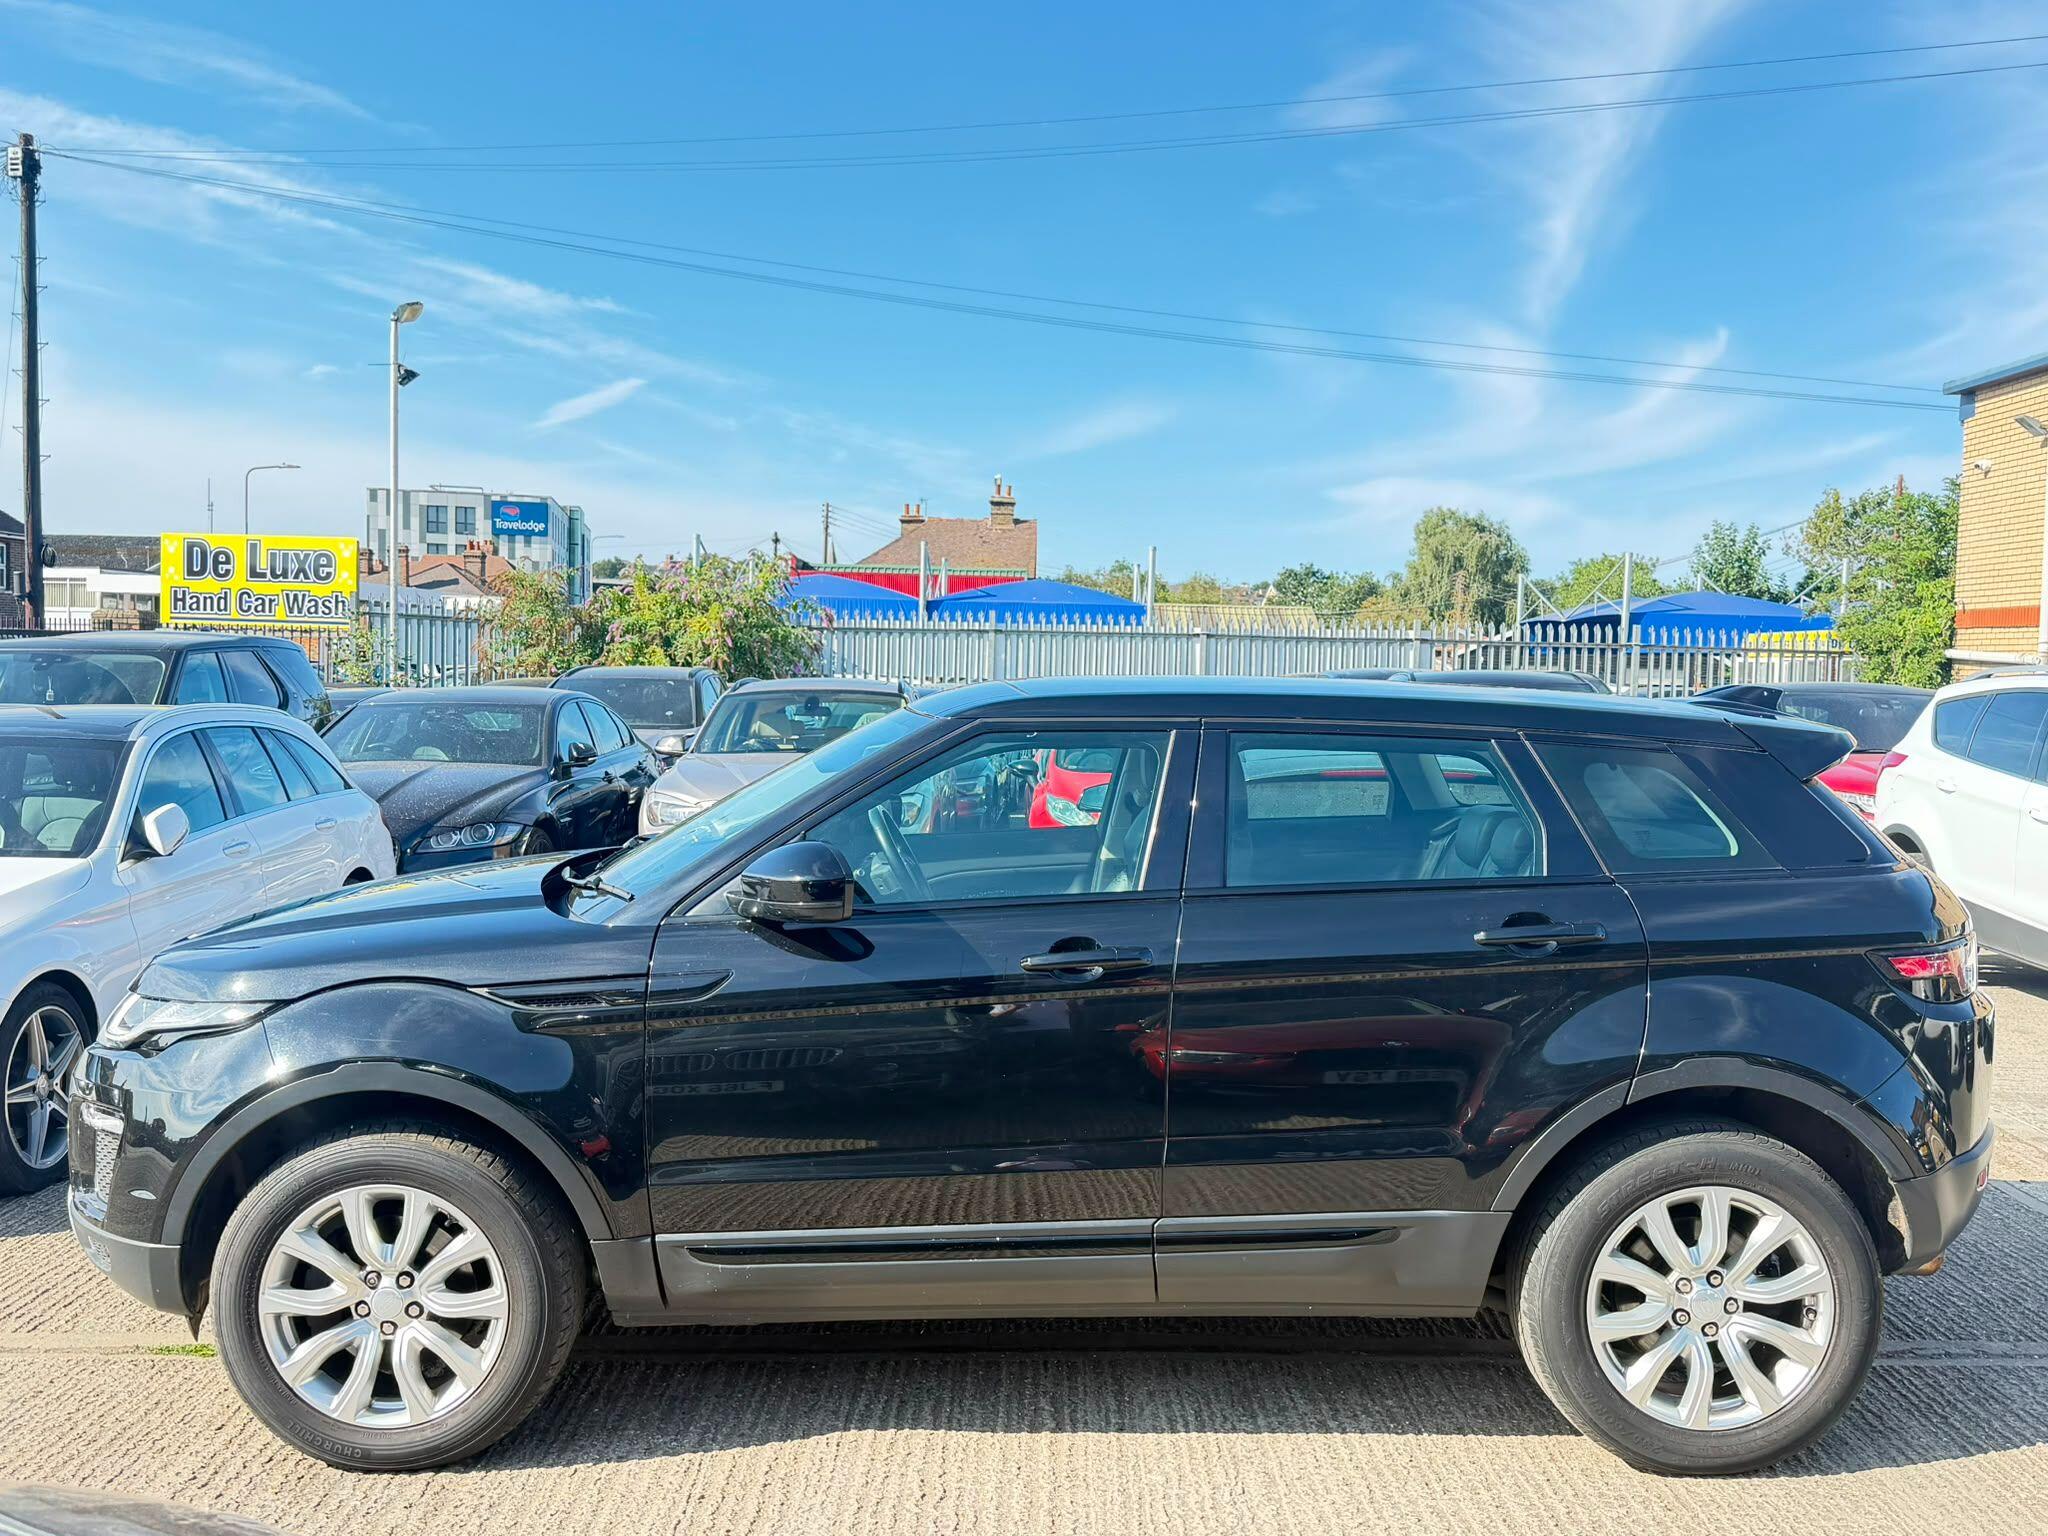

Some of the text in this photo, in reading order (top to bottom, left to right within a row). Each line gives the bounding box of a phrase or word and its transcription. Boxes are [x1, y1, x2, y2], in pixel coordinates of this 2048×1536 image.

[493, 518, 546, 533] Travelodge
[184, 538, 336, 584] De Luxe
[170, 586, 350, 618] Hand Car Wash
[287, 1419, 362, 1458] CHURCHILL
